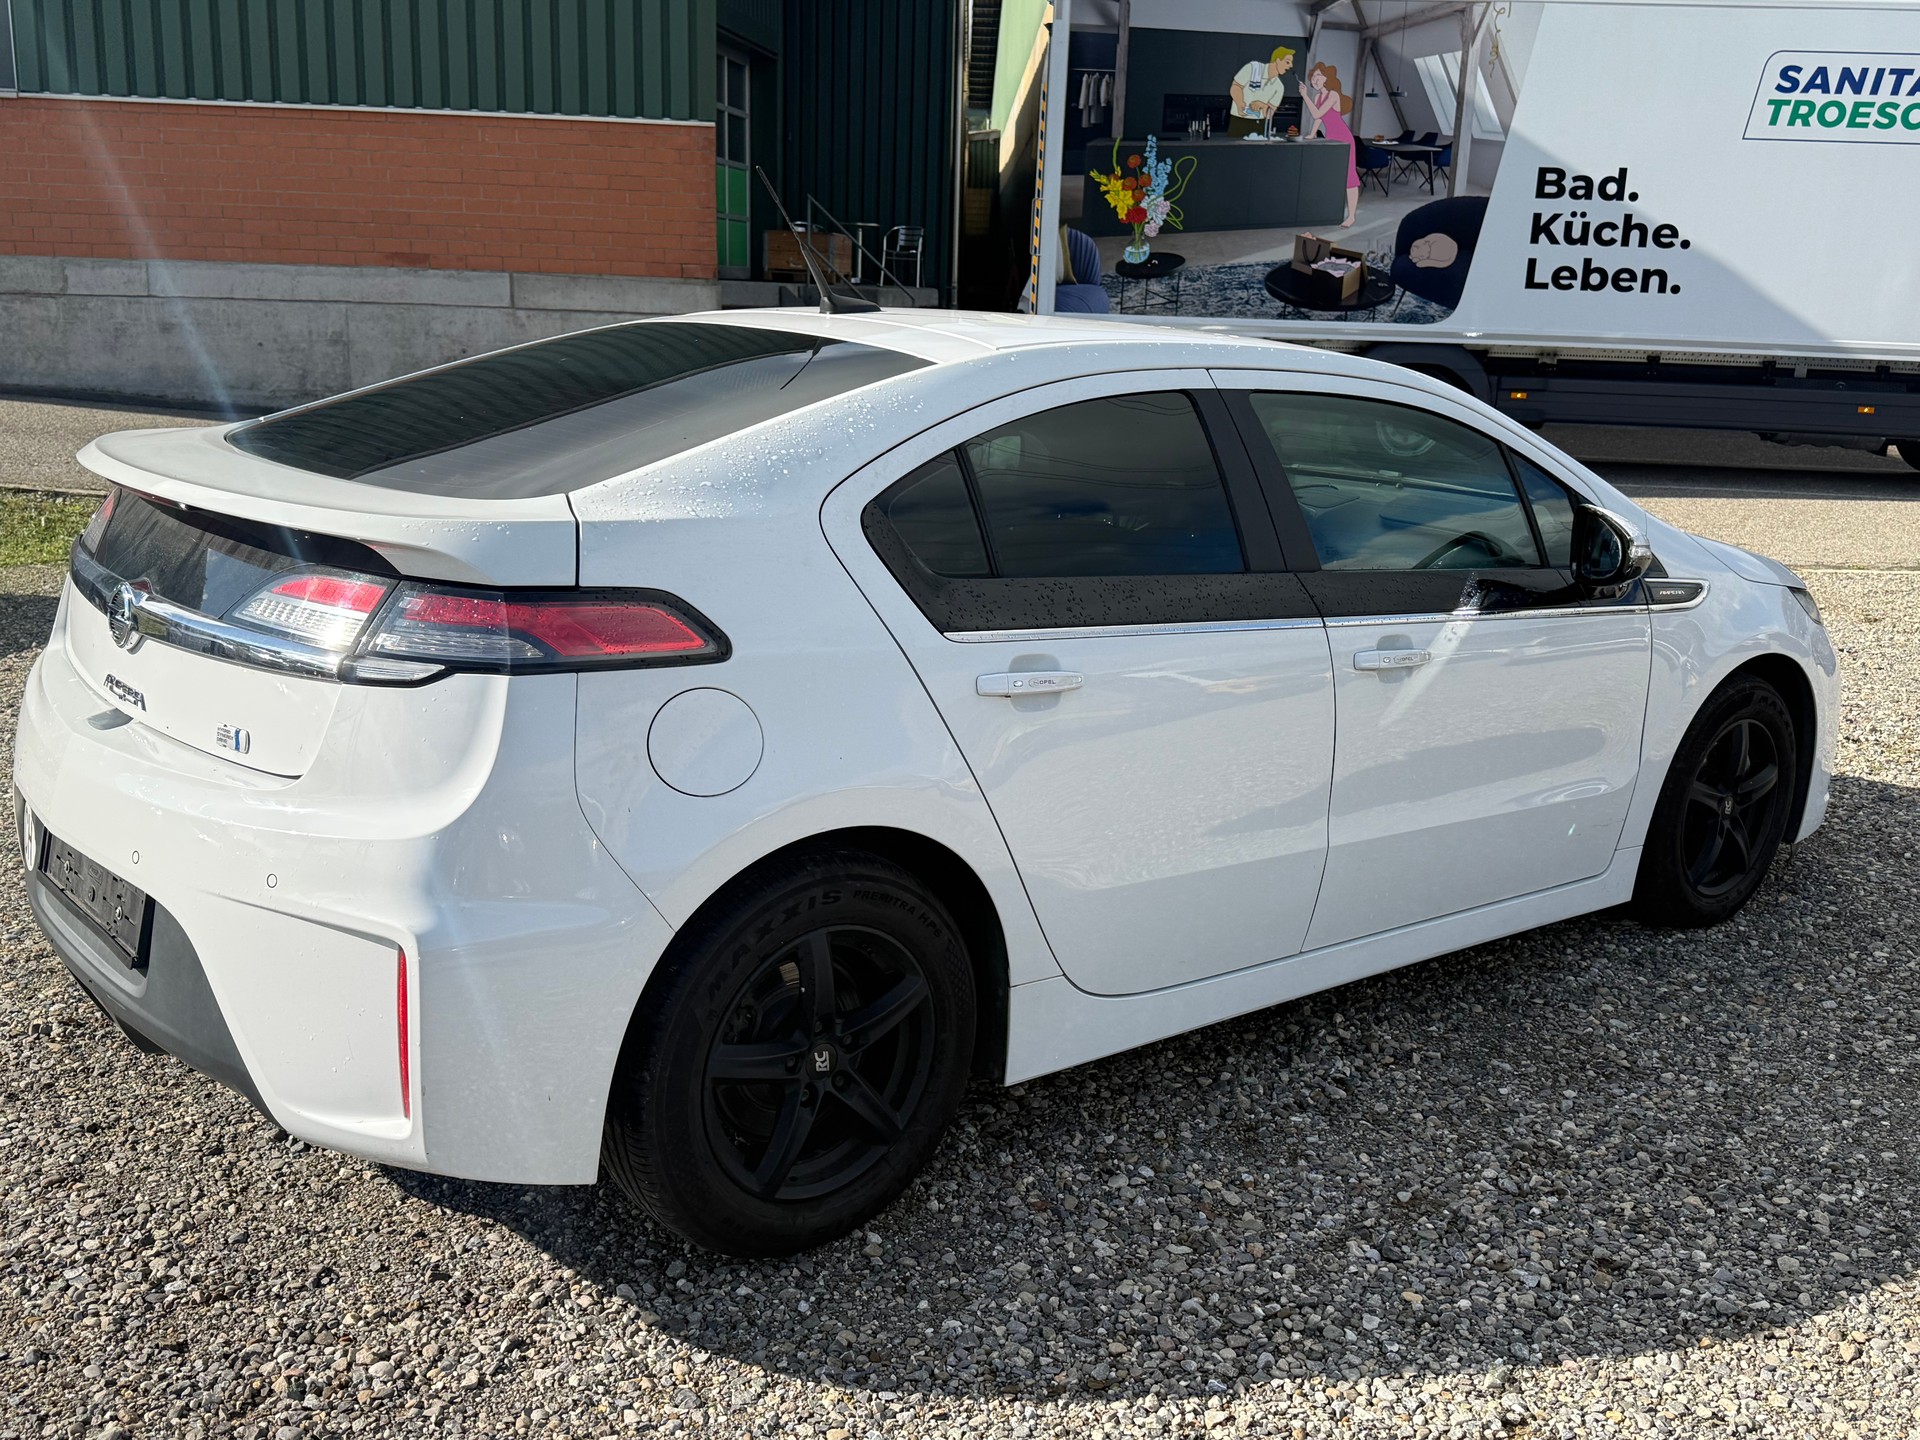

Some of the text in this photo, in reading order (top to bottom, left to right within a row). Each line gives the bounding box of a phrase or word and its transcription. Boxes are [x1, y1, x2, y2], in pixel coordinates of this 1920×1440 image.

[1534, 166, 1640, 203] Bad.
[1529, 209, 1691, 251] Küche.
[1524, 257, 1682, 295] Leben.
[706, 889, 843, 1001] MAXXIS
[852, 889, 916, 916] PREMITRA
[813, 1050, 830, 1072] RC
